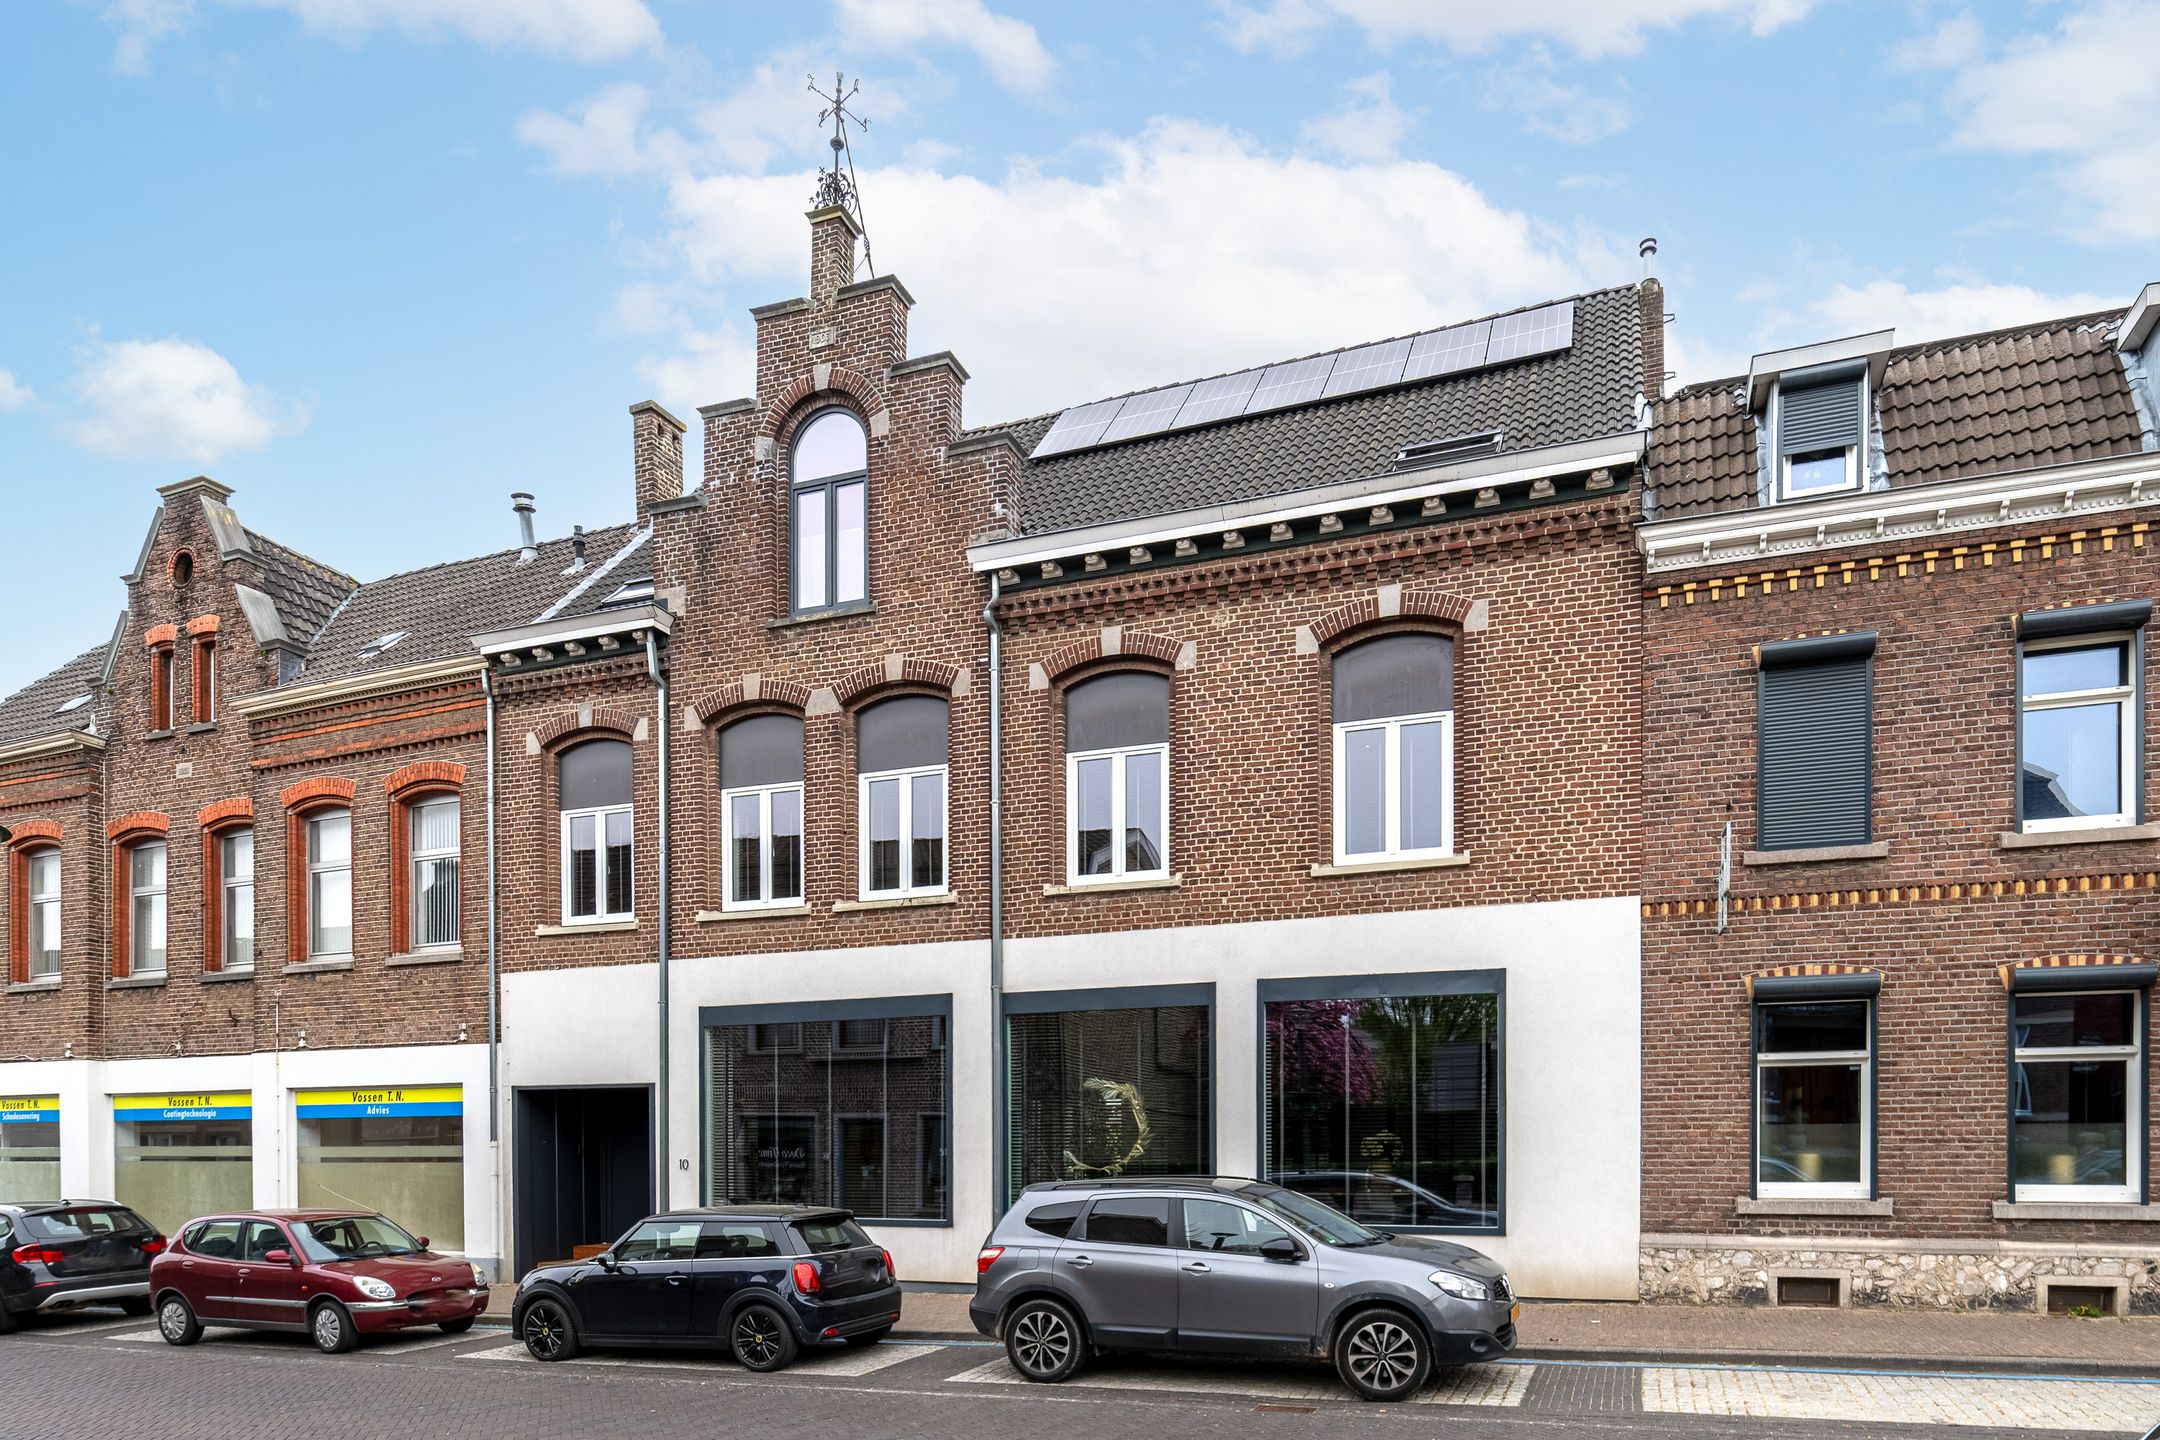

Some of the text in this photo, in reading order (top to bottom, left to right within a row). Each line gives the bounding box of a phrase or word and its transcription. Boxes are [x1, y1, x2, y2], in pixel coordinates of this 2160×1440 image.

[168, 1096, 195, 1107] Vossen
[352, 1091, 383, 1102] Vossen
[1, 1100, 25, 1110] Vossen
[367, 1105, 390, 1115] Advies
[679, 1158, 690, 1171] 10
